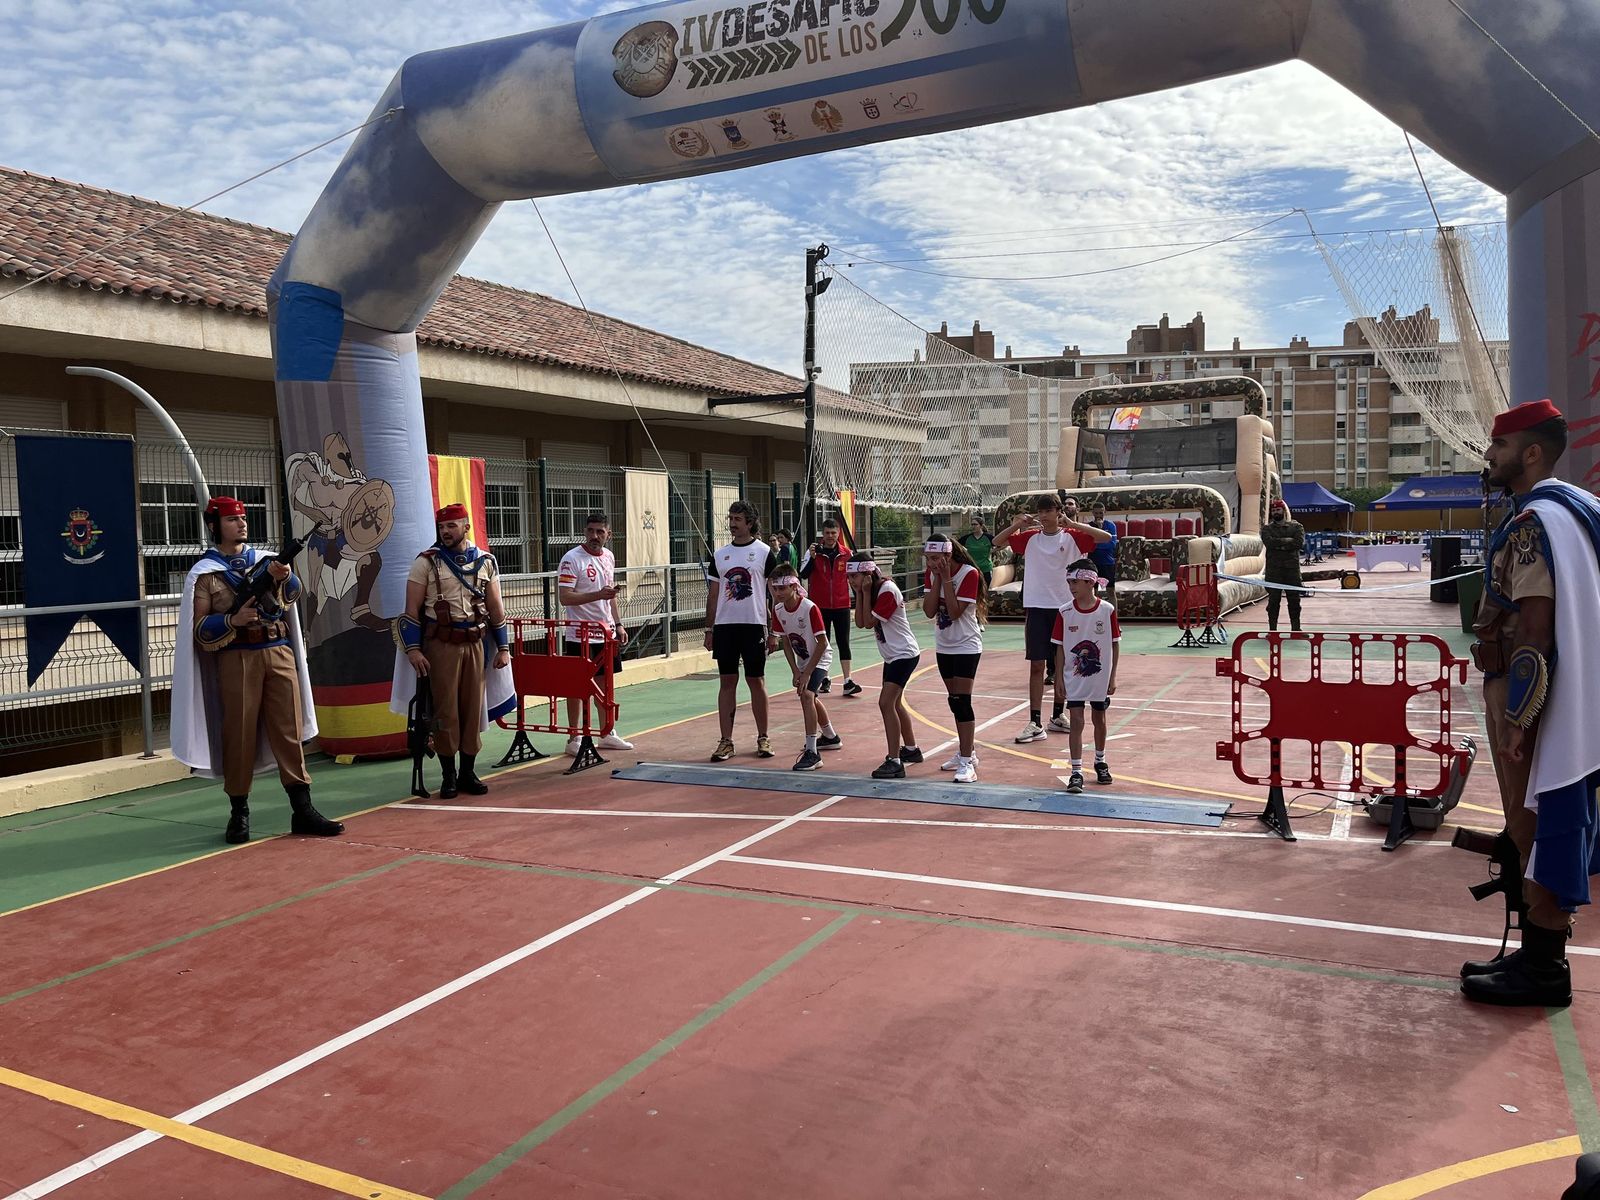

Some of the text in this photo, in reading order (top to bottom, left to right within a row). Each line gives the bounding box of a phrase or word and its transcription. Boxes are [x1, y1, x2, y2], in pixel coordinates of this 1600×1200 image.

[680, 11, 722, 57] IV
[803, 31, 831, 65] DE
[837, 21, 878, 57] LOS
